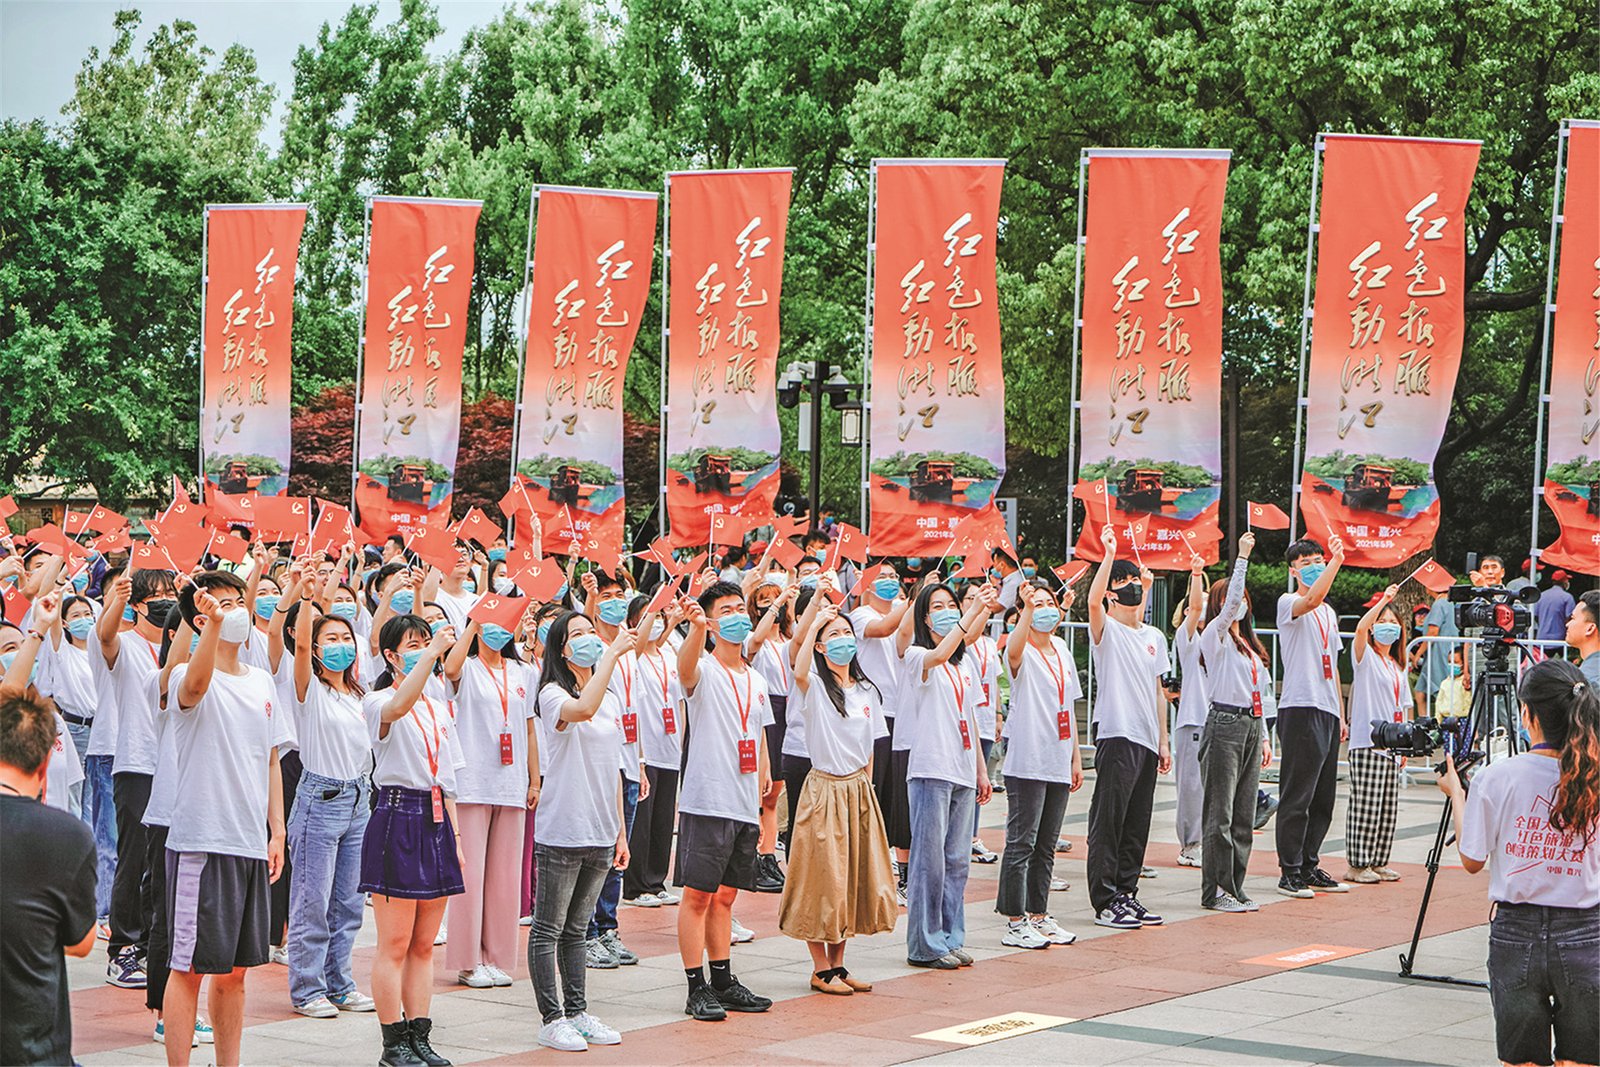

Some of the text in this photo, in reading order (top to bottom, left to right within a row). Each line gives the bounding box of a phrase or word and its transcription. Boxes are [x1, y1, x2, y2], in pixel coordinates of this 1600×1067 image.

[916, 517, 960, 528] 中国·嘉
[1123, 528, 1180, 541] 中·嘉兴
